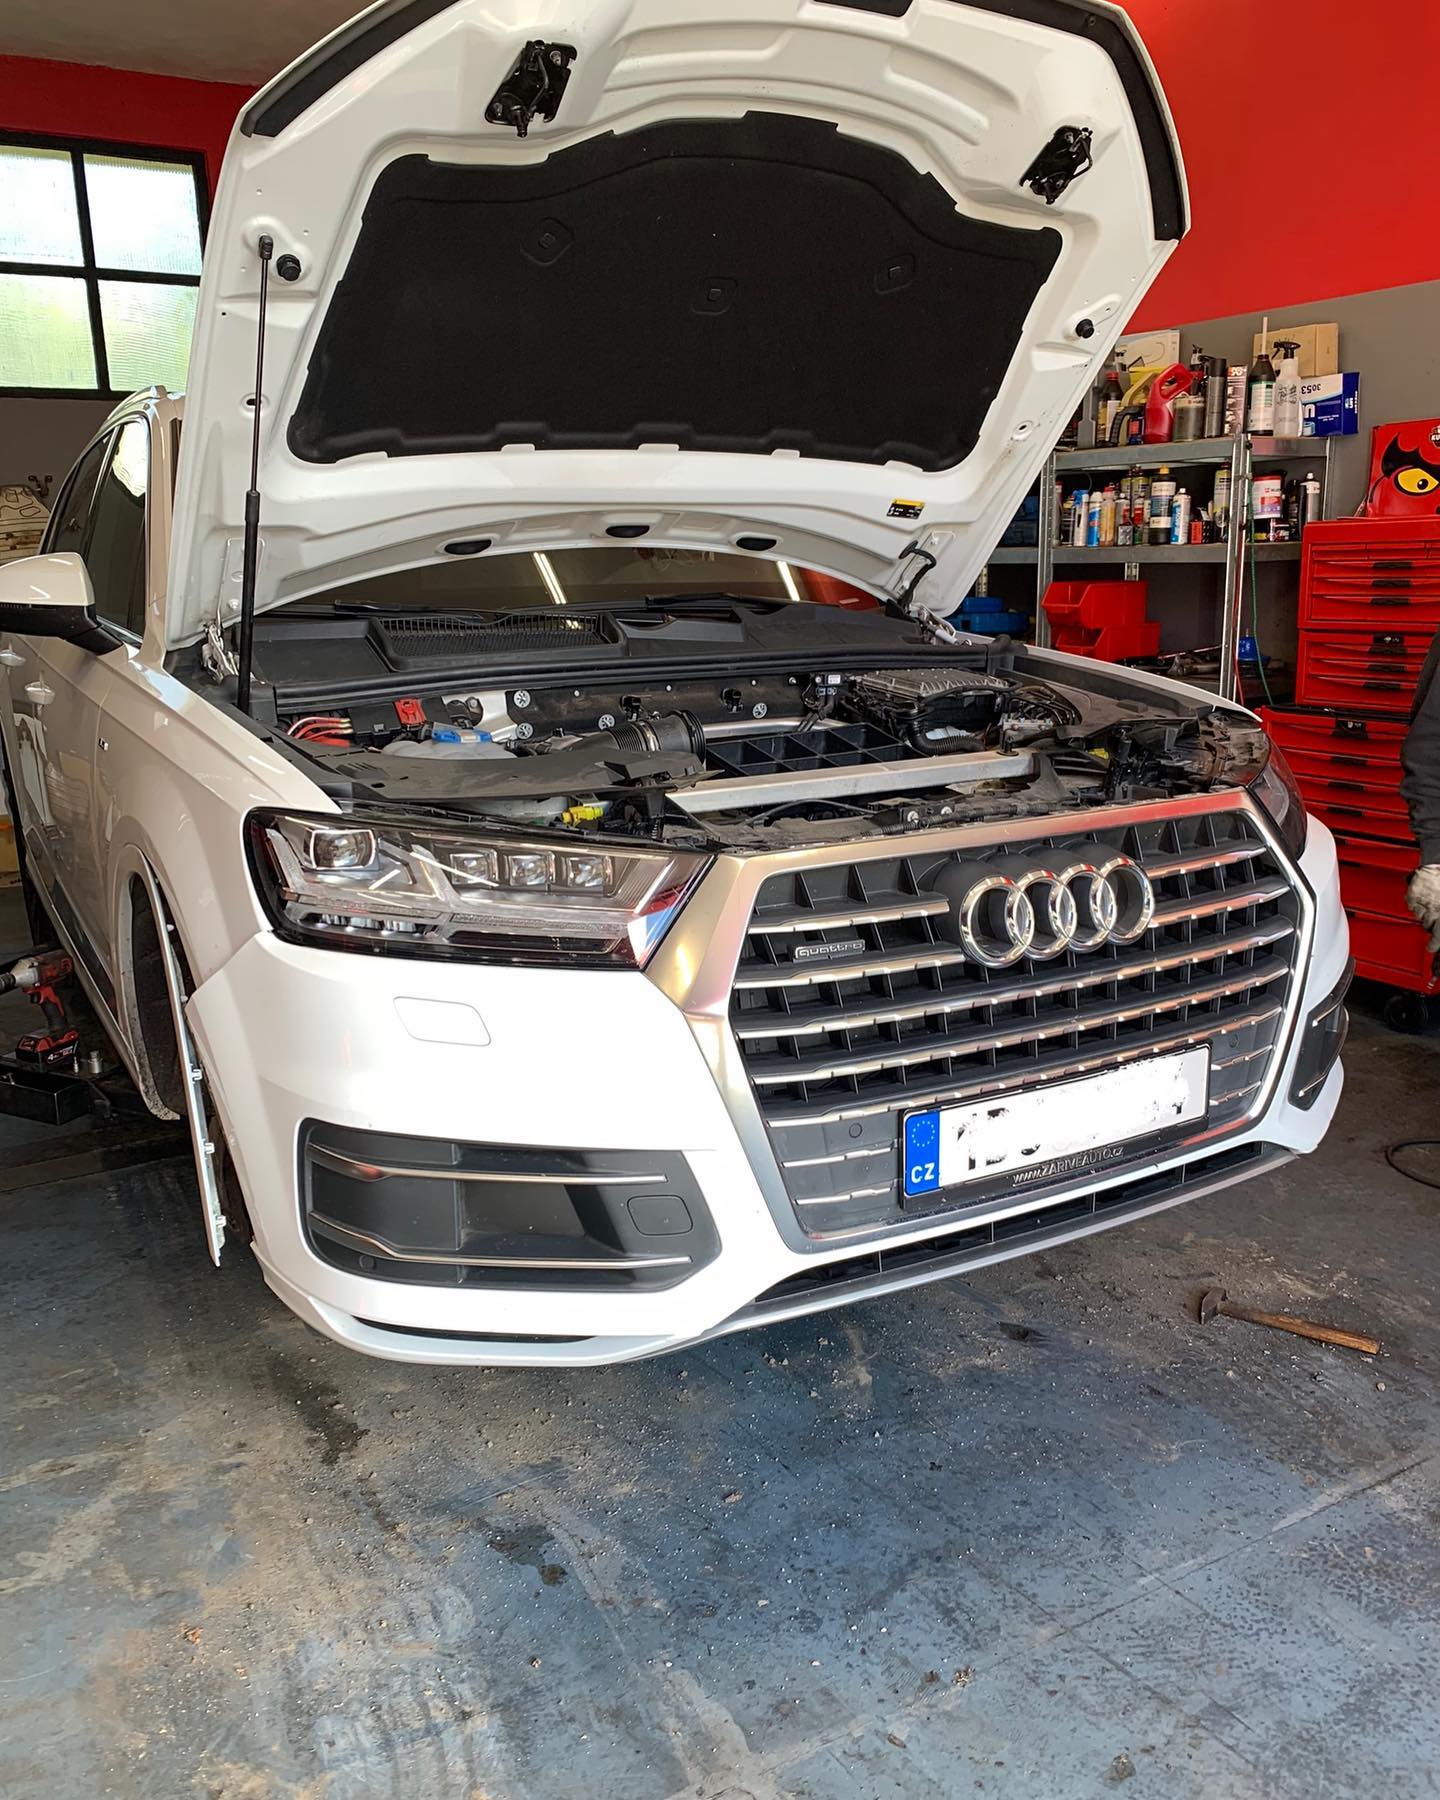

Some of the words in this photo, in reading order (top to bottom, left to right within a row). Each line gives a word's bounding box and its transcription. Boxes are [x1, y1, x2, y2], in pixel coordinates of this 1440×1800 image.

[1301, 383, 1321, 394] 3053
[797, 942, 863, 958] quattro
[911, 1162, 935, 1183] CZ
